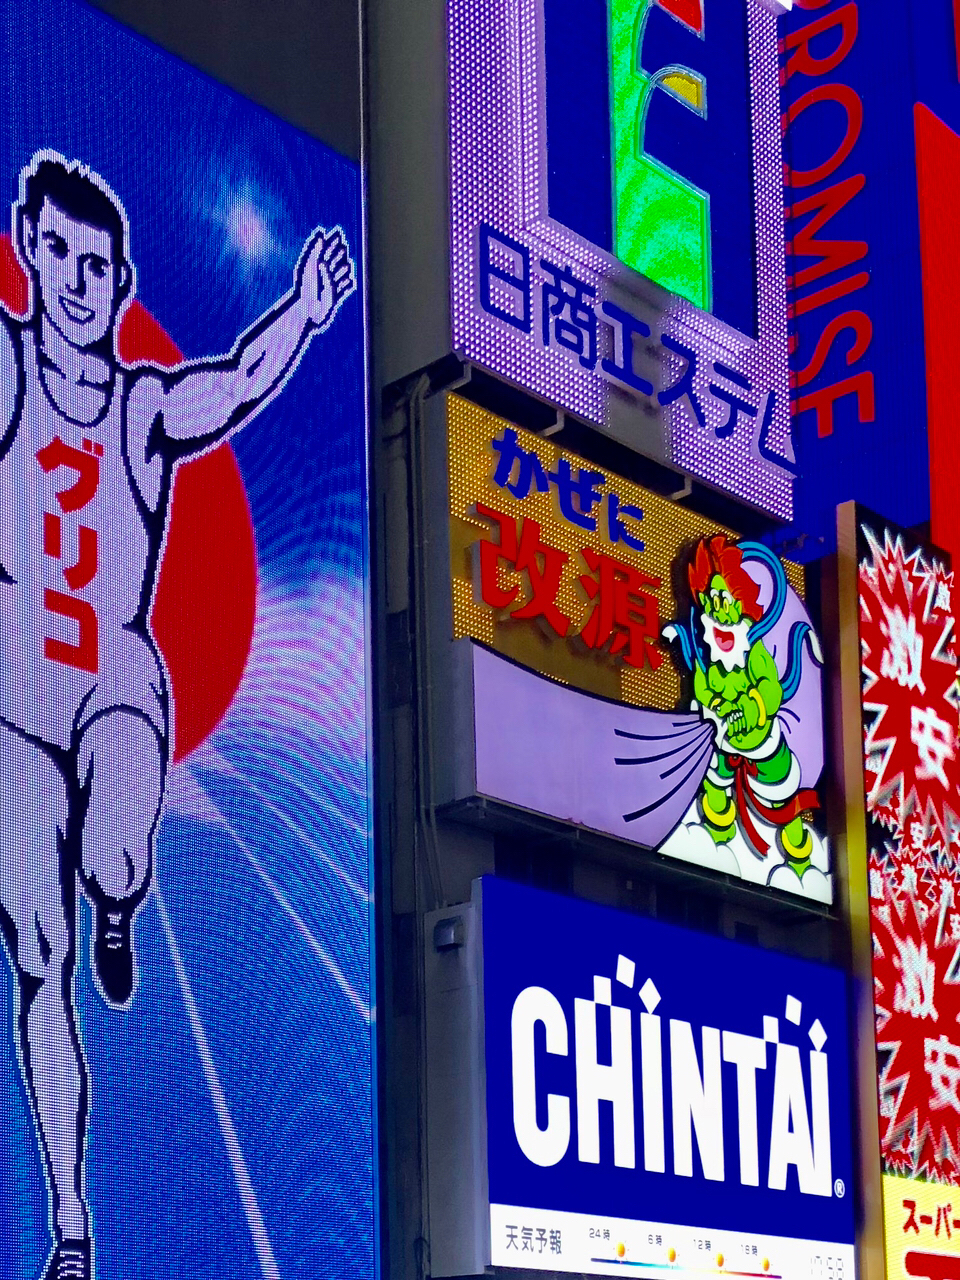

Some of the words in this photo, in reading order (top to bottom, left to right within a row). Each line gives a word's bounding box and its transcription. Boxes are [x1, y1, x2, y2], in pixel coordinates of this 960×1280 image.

[779, 0, 876, 438] ROMISE
[35, 434, 105, 676] グリコ
[491, 427, 646, 552] かぜに
[475, 501, 666, 673] 改源
[504, 1224, 563, 1256] 天気予報
[902, 1198, 960, 1240] スーパ
